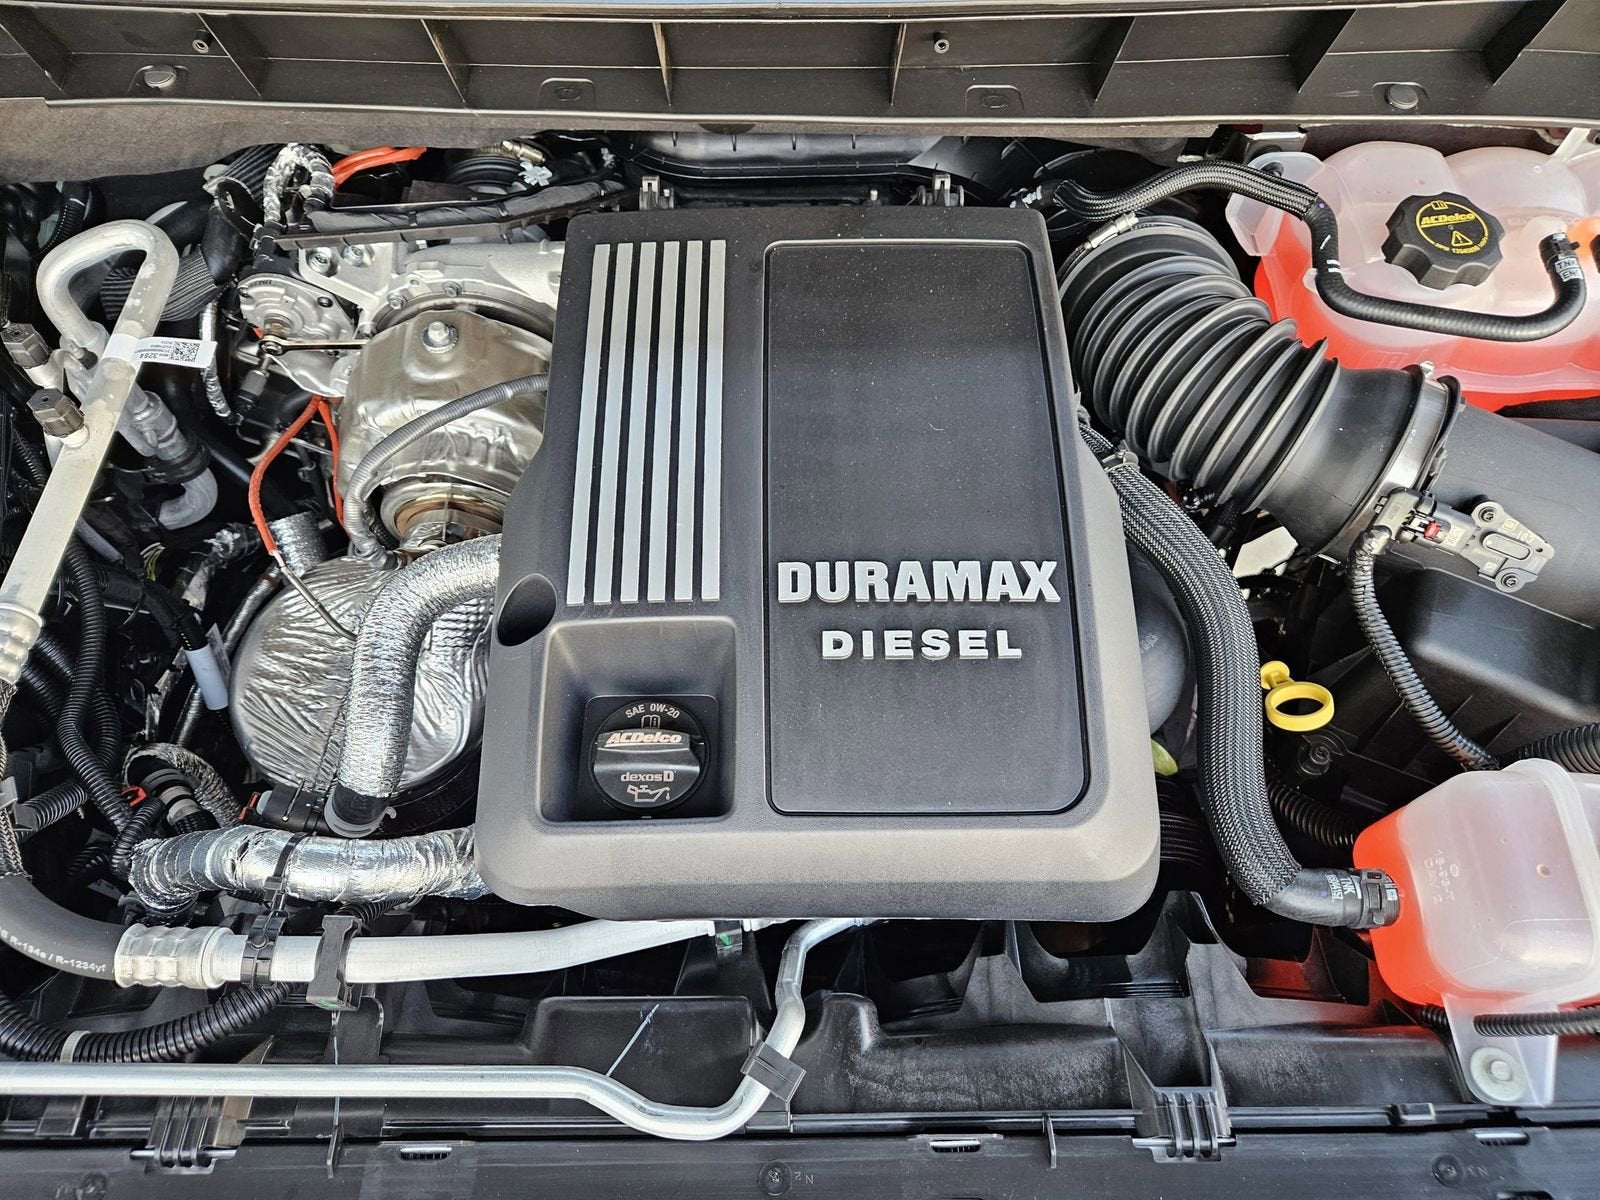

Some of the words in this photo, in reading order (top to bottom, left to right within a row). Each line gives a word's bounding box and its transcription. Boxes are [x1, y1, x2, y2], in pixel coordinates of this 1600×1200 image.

[1421, 213, 1476, 226] ACDelco
[777, 560, 1062, 604] DURAMAX
[821, 629, 1023, 661] DIESEL
[625, 704, 646, 719] SAE
[650, 702, 681, 719] 0W-20
[606, 731, 683, 744] ACDelco
[1340, 876, 1356, 895] TNK
[9, 935, 47, 959] R-134a
[55, 954, 107, 973] R-1234yf
